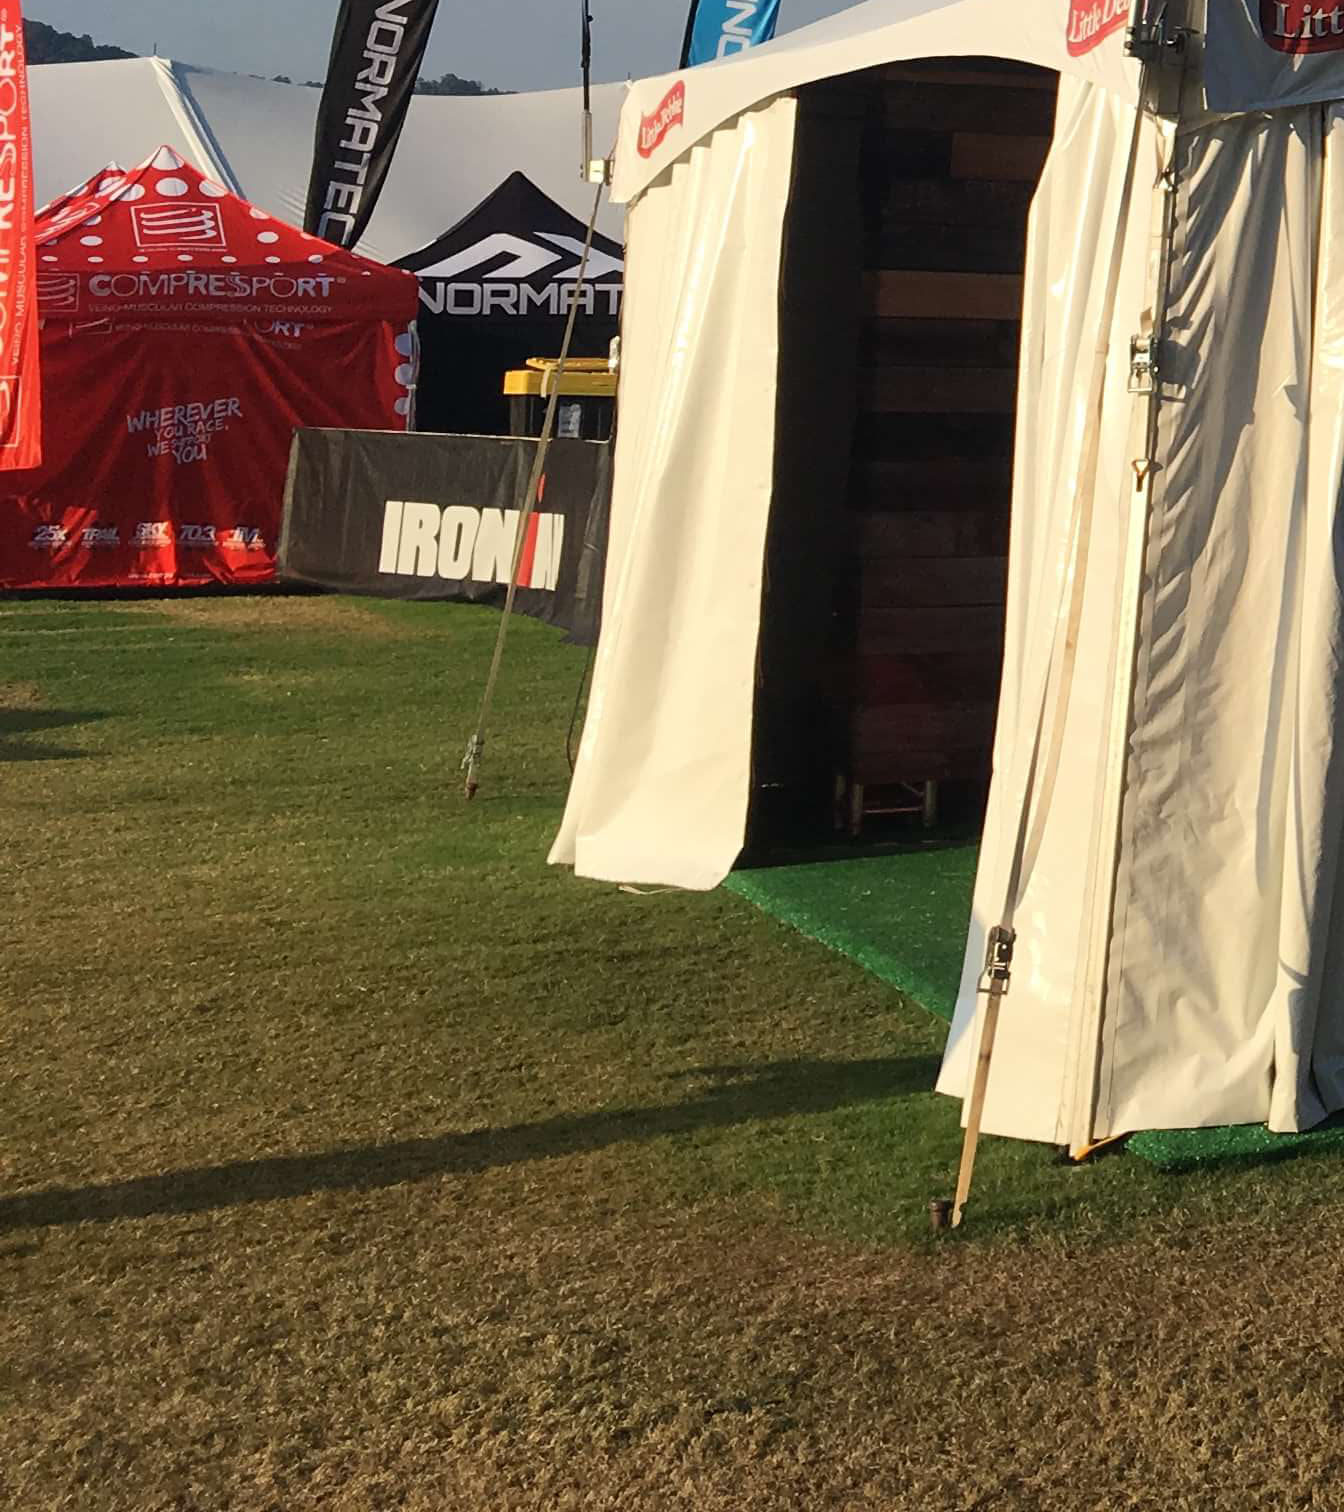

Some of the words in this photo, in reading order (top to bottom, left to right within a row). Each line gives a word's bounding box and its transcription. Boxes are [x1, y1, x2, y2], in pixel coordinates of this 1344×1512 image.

[1068, 2, 1103, 43] Little
[88, 272, 336, 298] COMPRESSPORT
[127, 397, 243, 433] WHEREVER
[172, 444, 207, 465] YOU
